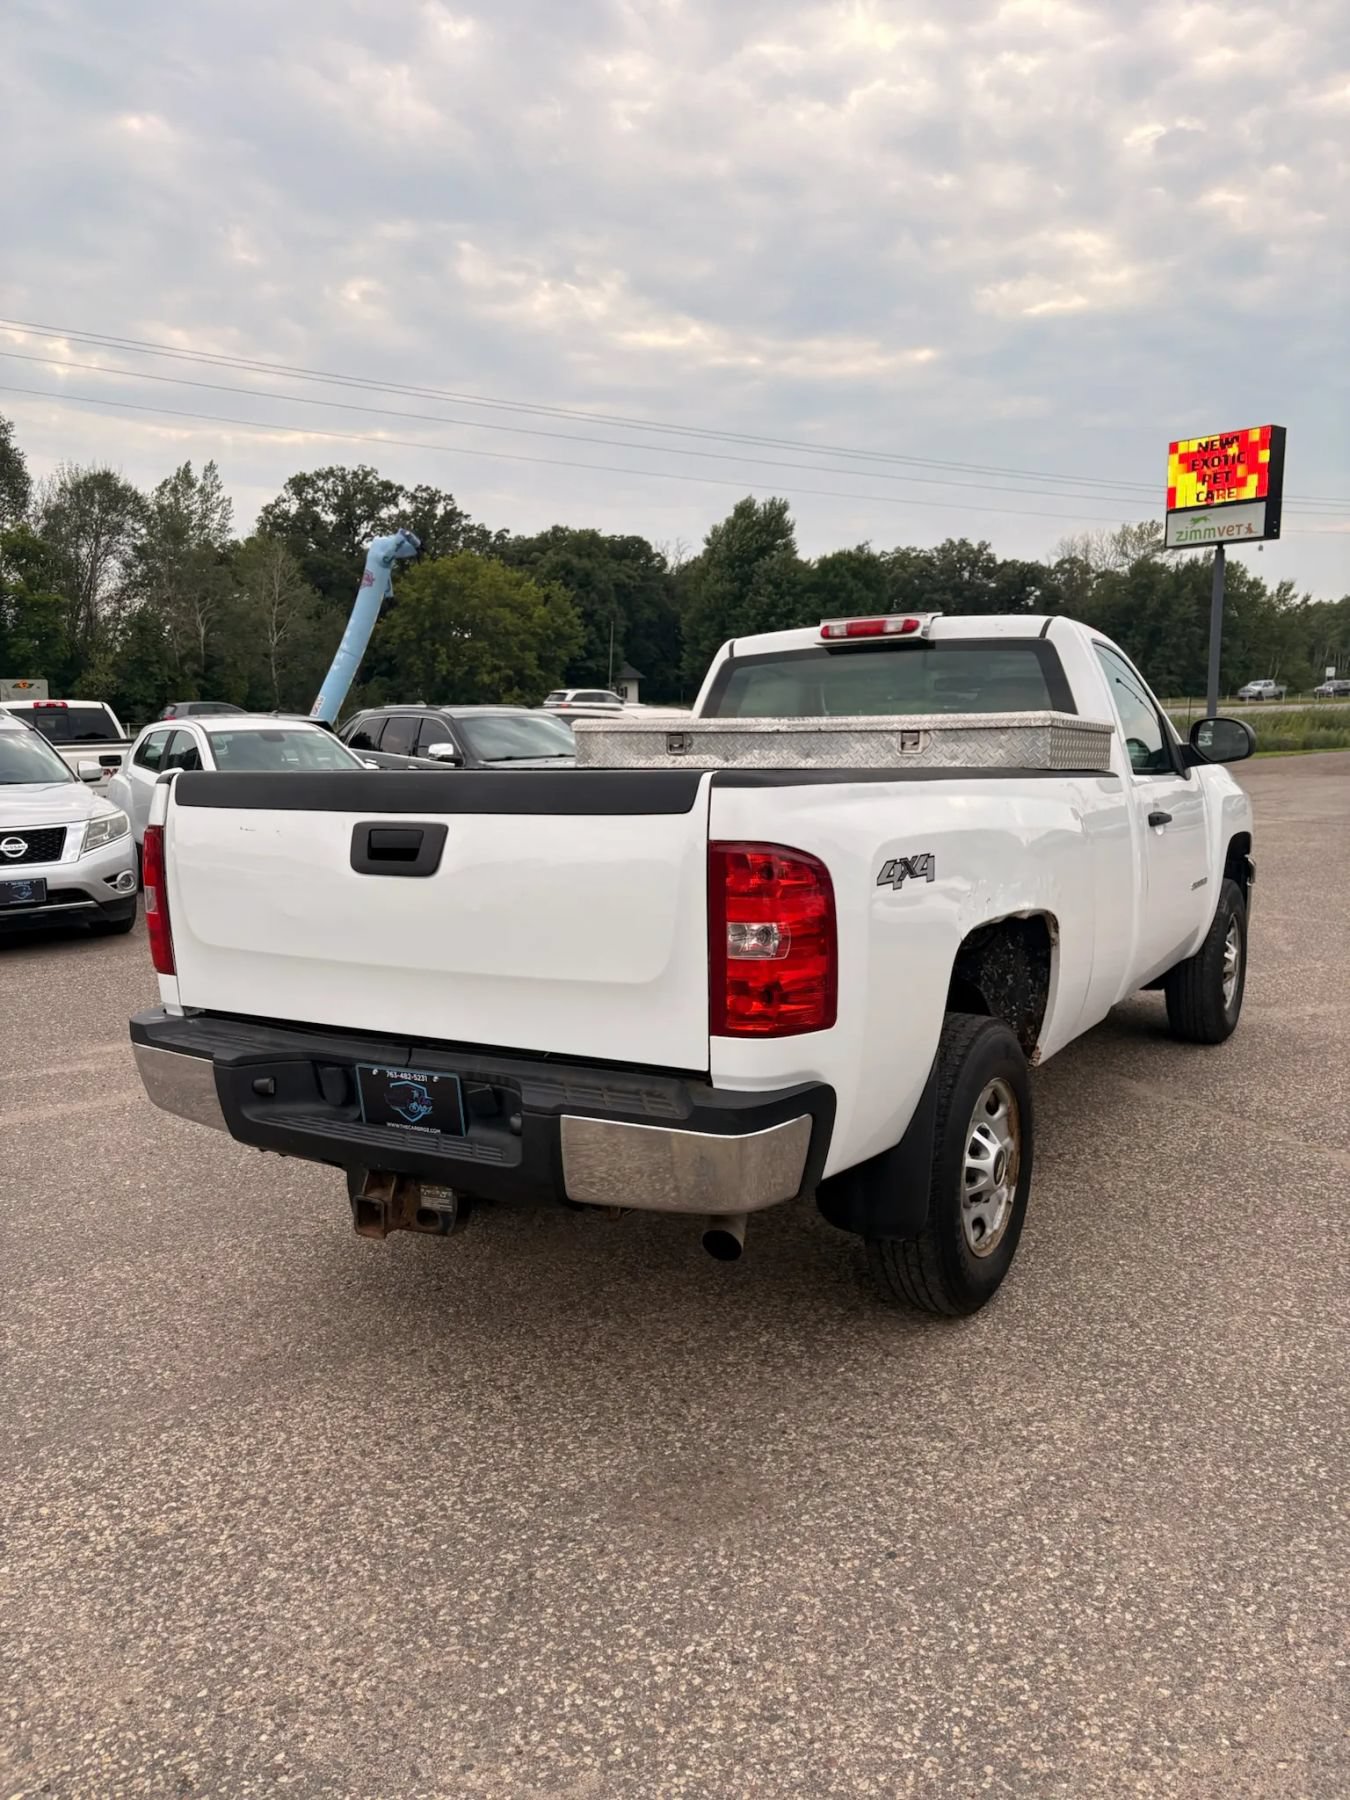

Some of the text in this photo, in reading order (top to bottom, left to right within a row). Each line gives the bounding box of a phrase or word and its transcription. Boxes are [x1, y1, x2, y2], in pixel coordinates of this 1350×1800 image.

[1191, 452, 1245, 470] EXOTIC
[1201, 471, 1231, 486] PET
[1196, 487, 1237, 503] CARE
[386, 1070, 428, 1083] 763-482-5231
